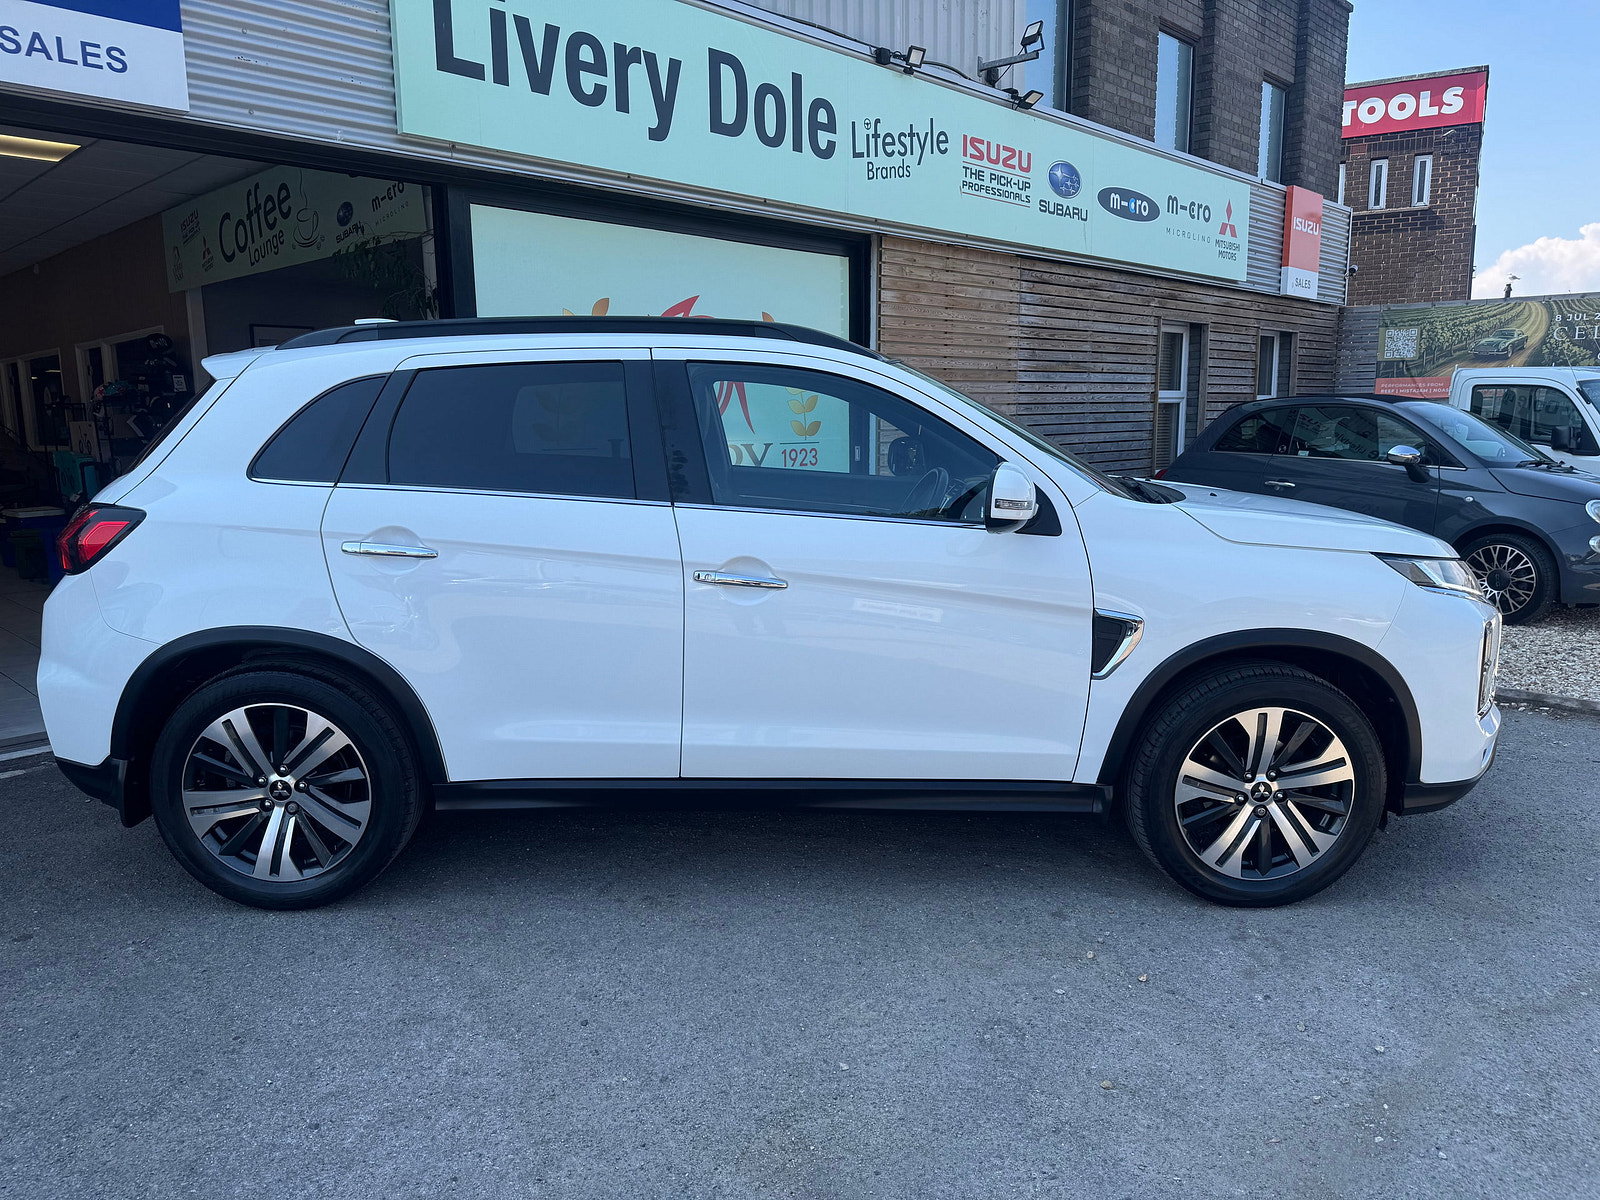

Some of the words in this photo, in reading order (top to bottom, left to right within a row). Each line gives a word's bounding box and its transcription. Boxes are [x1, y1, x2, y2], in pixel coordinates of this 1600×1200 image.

[0, 25, 128, 74] SALES
[432, 0, 682, 142] Livery
[708, 46, 838, 160] Dole
[1342, 86, 1465, 127] TOOLS
[851, 117, 949, 166] Lifestyle
[962, 134, 1032, 173] ISUZU
[866, 158, 911, 181] Brands
[962, 166, 986, 182] THE
[989, 171, 1031, 192] PICK-UP
[961, 180, 1031, 204] PROFESSIONALS
[1038, 199, 1089, 222] SUBARU
[218, 181, 292, 264] Coffee
[1292, 216, 1320, 236] ISUZU
[1165, 227, 1212, 245] MICROLINO
[1214, 238, 1241, 253] MITSUBISHI
[249, 229, 286, 267] Lounge
[1217, 249, 1238, 262] MOTORS
[1294, 277, 1312, 290] SALES
[1555, 314, 1562, 322] 8
[1566, 313, 1589, 321] JUL
[781, 447, 818, 468] 1923
